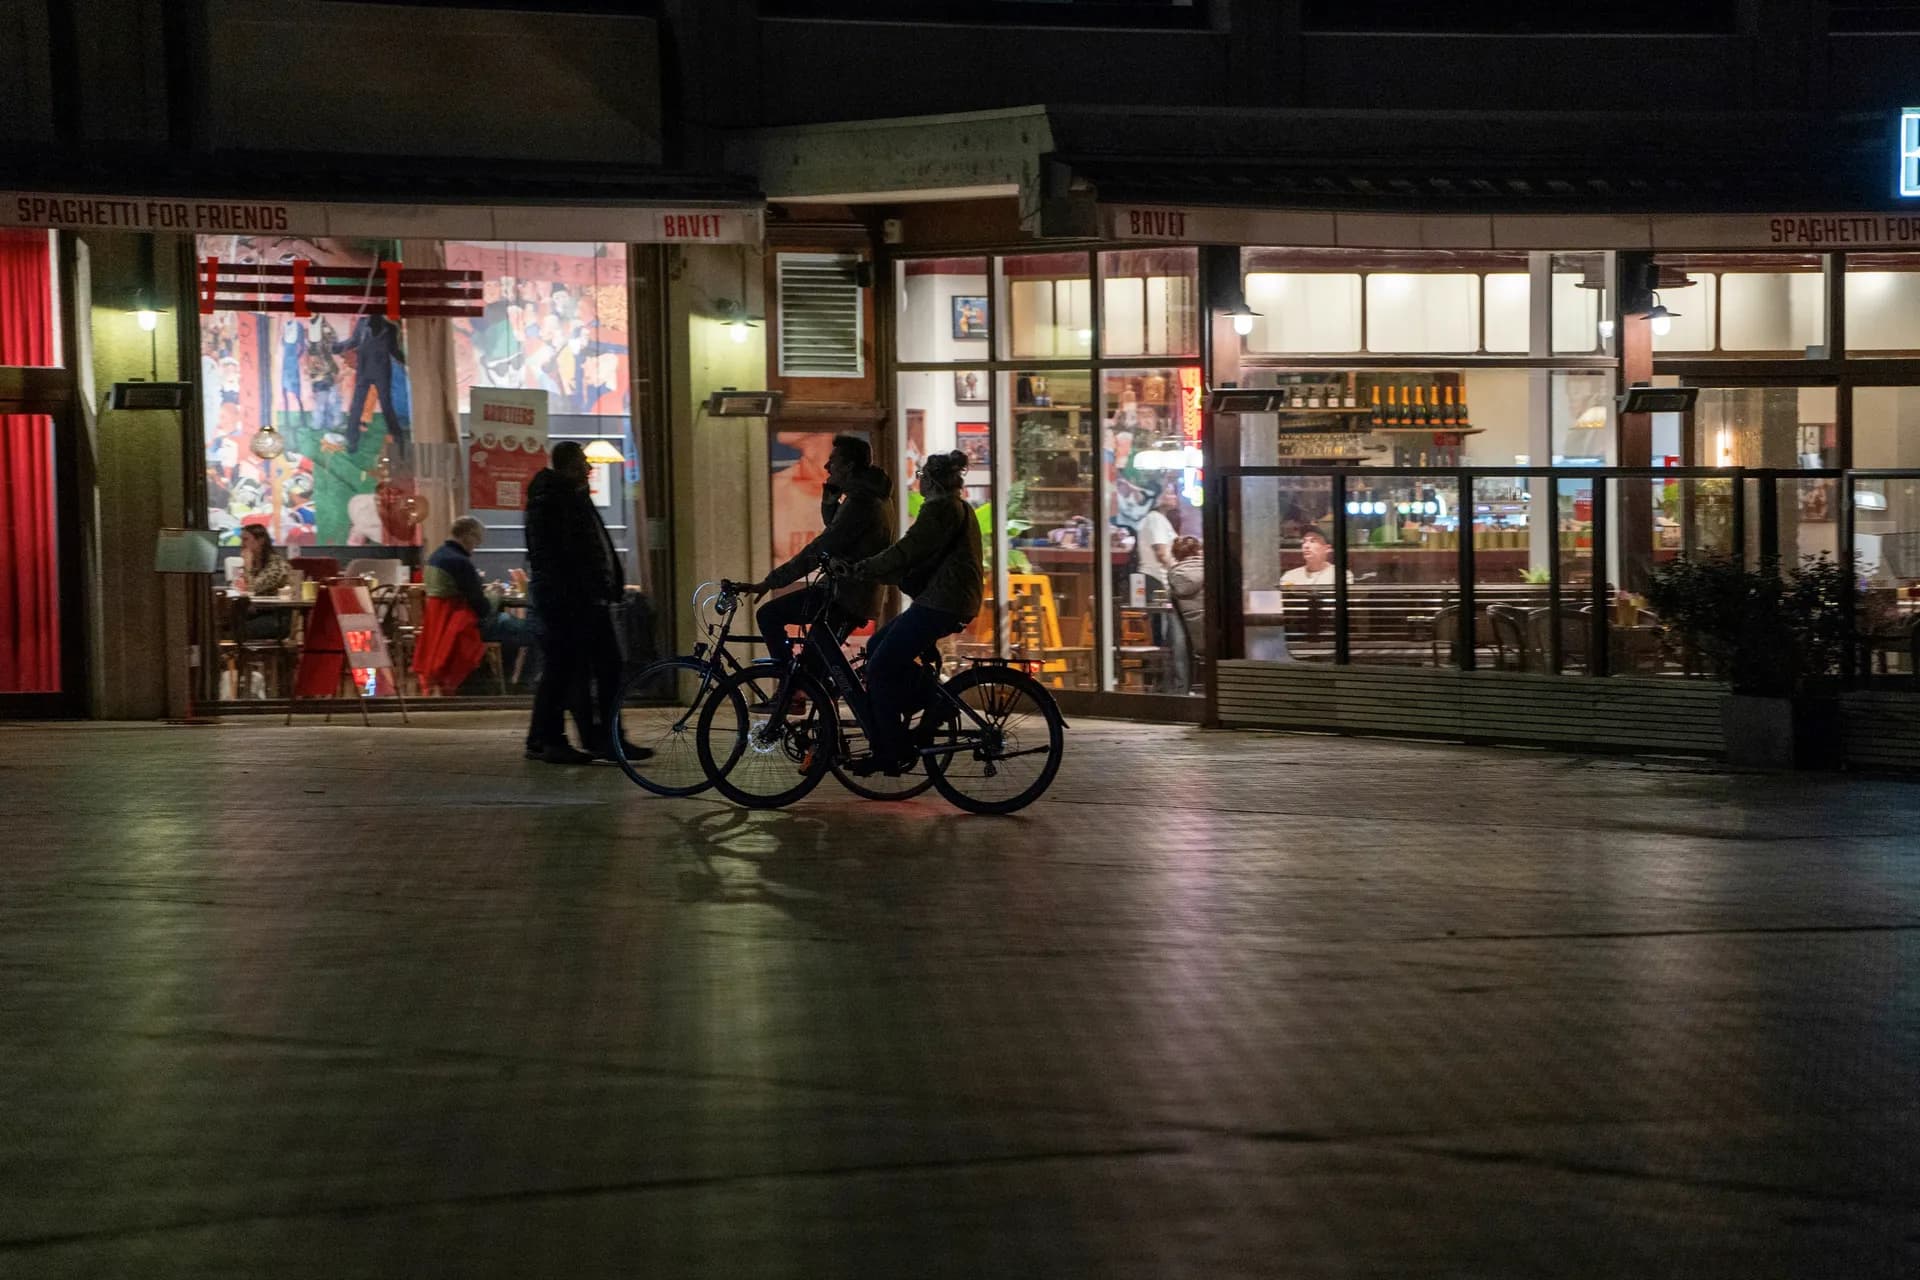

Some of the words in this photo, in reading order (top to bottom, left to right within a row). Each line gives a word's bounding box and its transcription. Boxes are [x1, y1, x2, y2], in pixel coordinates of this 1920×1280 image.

[18, 197, 139, 227] SPAGHETTI
[147, 202, 190, 228] FOR
[195, 204, 288, 231] FRIENDS
[663, 214, 721, 238] BAVET
[1130, 211, 1186, 236] BAVET
[1770, 218, 1879, 243] SPAGHETTI
